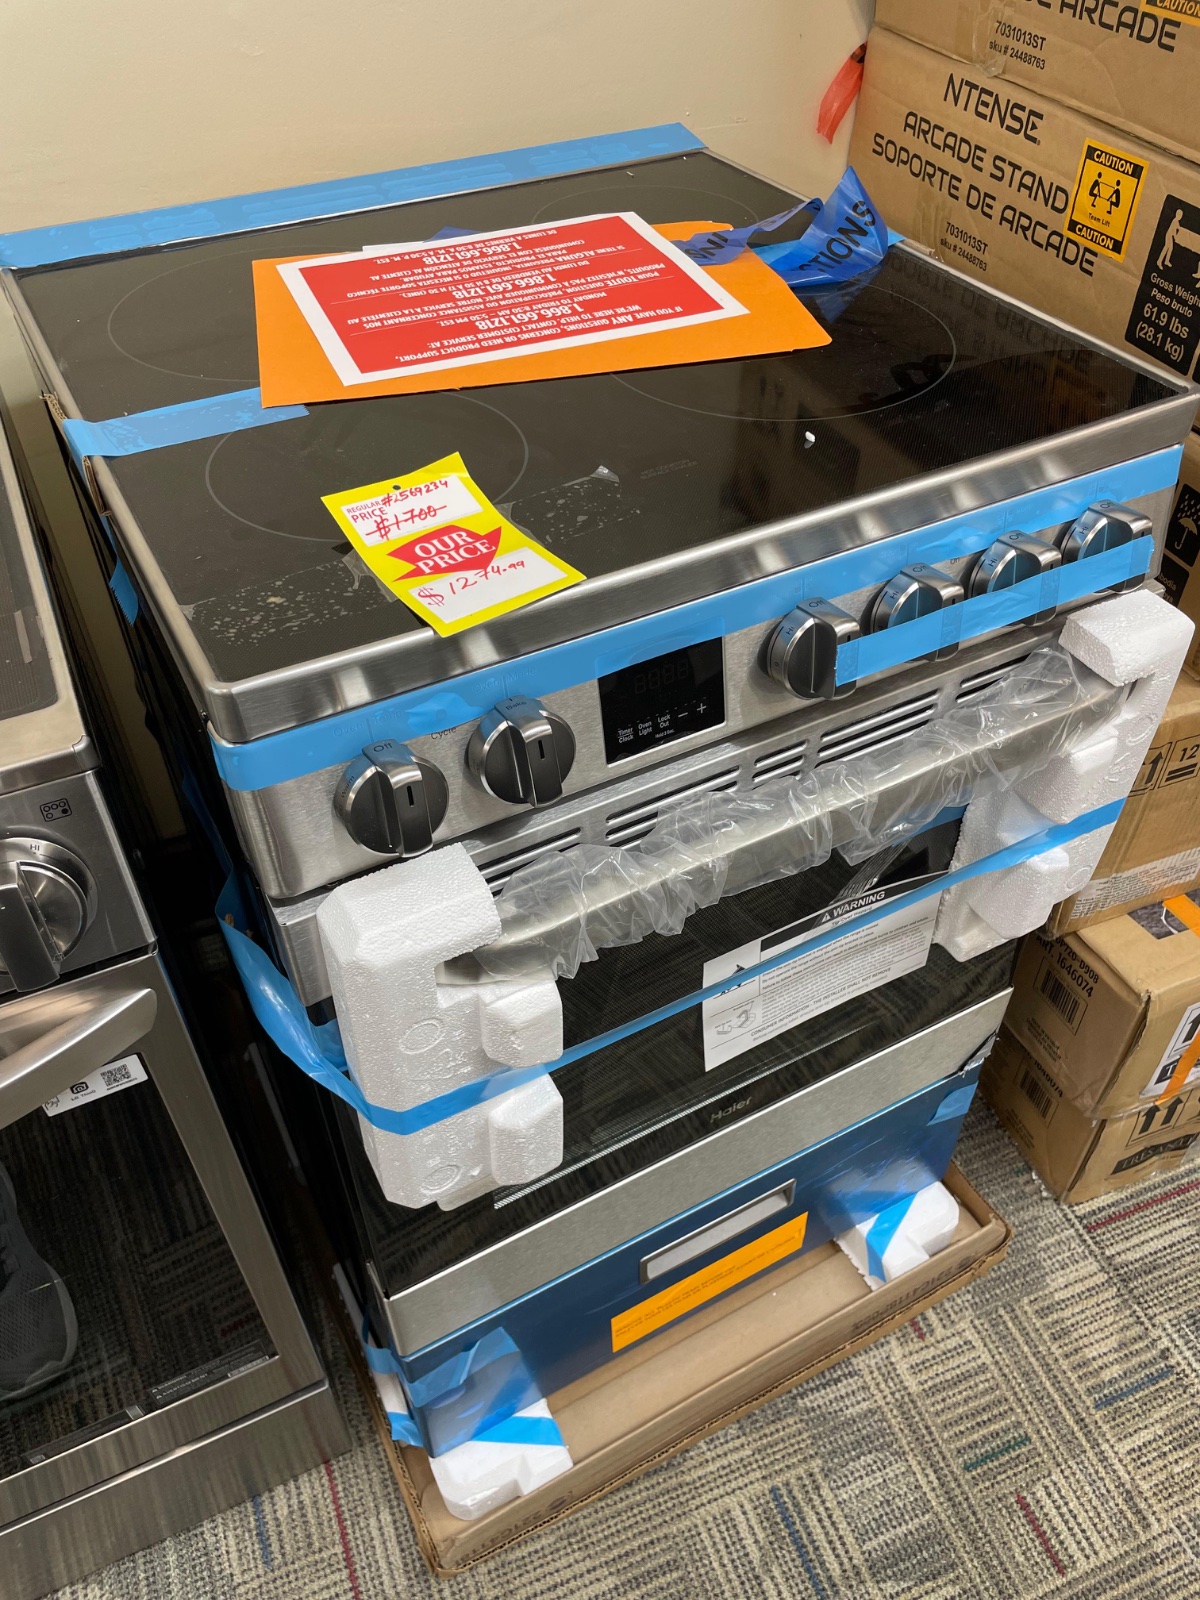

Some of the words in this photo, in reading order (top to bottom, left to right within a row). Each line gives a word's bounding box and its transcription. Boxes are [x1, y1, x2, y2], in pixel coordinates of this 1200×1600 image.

[1059, 0, 1181, 52] ARCADE
[995, 20, 1046, 50] 7031013ST
[988, 40, 1003, 53] sku
[1009, 47, 1046, 70] 24488763
[943, 73, 1043, 144] NTENSE
[903, 111, 987, 173] ARCADE
[989, 155, 1069, 214] STAND
[1094, 151, 1133, 175] CAUTION
[872, 132, 962, 201] SOPORTE
[965, 183, 997, 220] DE
[999, 204, 1098, 277] ARCADE
[1088, 212, 1101, 223] Team
[1102, 218, 1110, 227] Lift
[522, 231, 546, 239] LUNES
[945, 221, 988, 255] 7031013ST
[1075, 224, 1114, 250] CAUTION
[484, 237, 516, 246] VIERNES
[532, 239, 585, 253] COMUNÍQUESE
[422, 242, 522, 265] 1.866.661.1218
[545, 249, 567, 257] PARA
[554, 250, 595, 262] ALGUNA
[940, 237, 951, 250] sku
[957, 247, 987, 271] 24488763
[473, 254, 507, 264] SERVICIO
[492, 255, 536, 266] PRODUCTO,
[511, 258, 555, 268] PREGUNTA,
[423, 262, 460, 272] ATENCIÓN
[457, 263, 493, 273] ESTAMOS
[470, 266, 512, 277] INQUIETUD
[553, 262, 577, 271] LUNDI
[624, 263, 665, 274] PRODUITS,
[381, 270, 411, 279] CLIENTE
[399, 273, 434, 282] AYUDAR.
[501, 270, 541, 281] VENDREDI
[585, 270, 625, 282] N'HÉSITEZ
[636, 271, 660, 279] POUR
[416, 276, 453, 286] NECESITA
[452, 273, 556, 299] 1.866.661.1218
[604, 275, 639, 286] TOUTE
[380, 282, 417, 292] SOPORTE
[504, 283, 562, 298] COMMUNIQUER
[562, 281, 604, 293] QUESTION,
[1150, 272, 1173, 292] Gross
[1175, 284, 1200, 307] Weigh
[346, 288, 380, 298] TÉCNICO
[399, 290, 427, 298] (HNE).
[499, 290, 563, 305] PRÉOCCUPATION
[573, 291, 607, 302] MONDAY
[422, 302, 455, 311] SERVICE
[455, 297, 483, 306] NOTRE
[532, 300, 561, 310] FRIDAY
[1151, 288, 1171, 305] Peso
[1171, 299, 1193, 318] bruto
[437, 304, 484, 316] ASSISTANCE
[592, 309, 615, 318] HERE
[614, 304, 642, 314] WE'RE
[633, 310, 657, 319] HAVE
[360, 311, 402, 322] CLIENTÈLE
[383, 312, 437, 325] CONCERNANT
[469, 313, 488, 321] 5:30
[475, 303, 584, 330] 1.866.661.1218
[557, 315, 581, 323] HELP.
[611, 314, 633, 325] ANY
[1143, 303, 1168, 326] 61.9
[1169, 316, 1189, 339] lbs
[363, 321, 382, 329] NOS
[521, 320, 557, 331] CONTACT
[560, 319, 609, 331] QUESTIONS,
[476, 326, 520, 339] CUSTOMER
[517, 327, 561, 340] CONCERNS
[441, 335, 477, 346] SERVICE
[480, 338, 504, 346] NEED
[1136, 321, 1163, 347] (28.1
[1164, 337, 1185, 362] kg)
[440, 342, 480, 355] PRODUCT
[395, 350, 439, 362] SUPPORT,
[381, 480, 448, 506] #2569234
[346, 500, 380, 514] REGULAR
[351, 507, 387, 523] PRICE
[414, 531, 475, 557] OUR
[416, 539, 496, 574] PRICE
[988, 558, 998, 567] Hi
[418, 586, 445, 606] $
[449, 560, 525, 595] 1274.99
[808, 599, 825, 608] Off
[785, 626, 795, 636] Hi
[505, 701, 527, 711] Bake
[657, 714, 671, 723] Lock
[638, 721, 652, 730] Oven
[660, 721, 670, 729] Out
[430, 726, 457, 741] Cycle
[618, 727, 633, 736] Timer
[639, 727, 652, 736] Light
[619, 734, 634, 743] Clock
[373, 742, 392, 753] Off
[1179, 744, 1200, 762] 12
[833, 891, 885, 917] WARNING
[1057, 953, 1093, 998] 1646074
[711, 1097, 752, 1123] Haier
